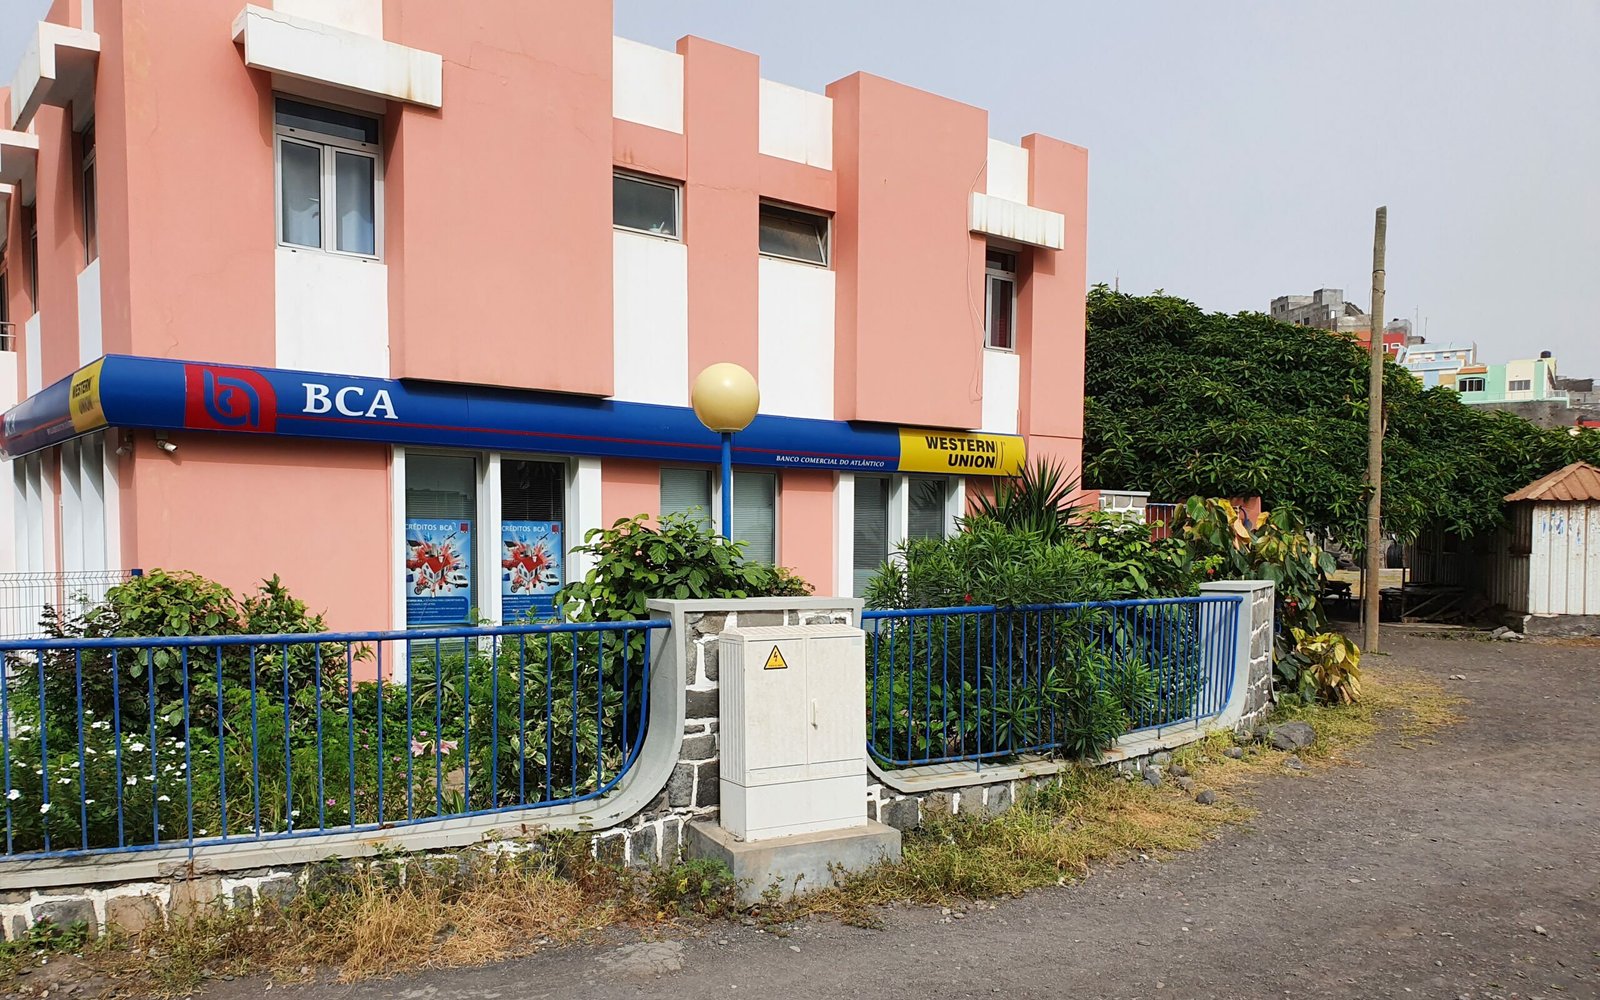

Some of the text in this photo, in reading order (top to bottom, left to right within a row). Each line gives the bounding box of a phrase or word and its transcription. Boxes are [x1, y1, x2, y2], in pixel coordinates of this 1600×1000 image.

[302, 382, 399, 419] BCA
[926, 436, 995, 453] WESTERN
[776, 455, 885, 468] BANCO COMERCIAL DO ATLÂNTICO
[948, 454, 995, 468] UNION
[502, 524, 531, 532] CRÉDITOS
